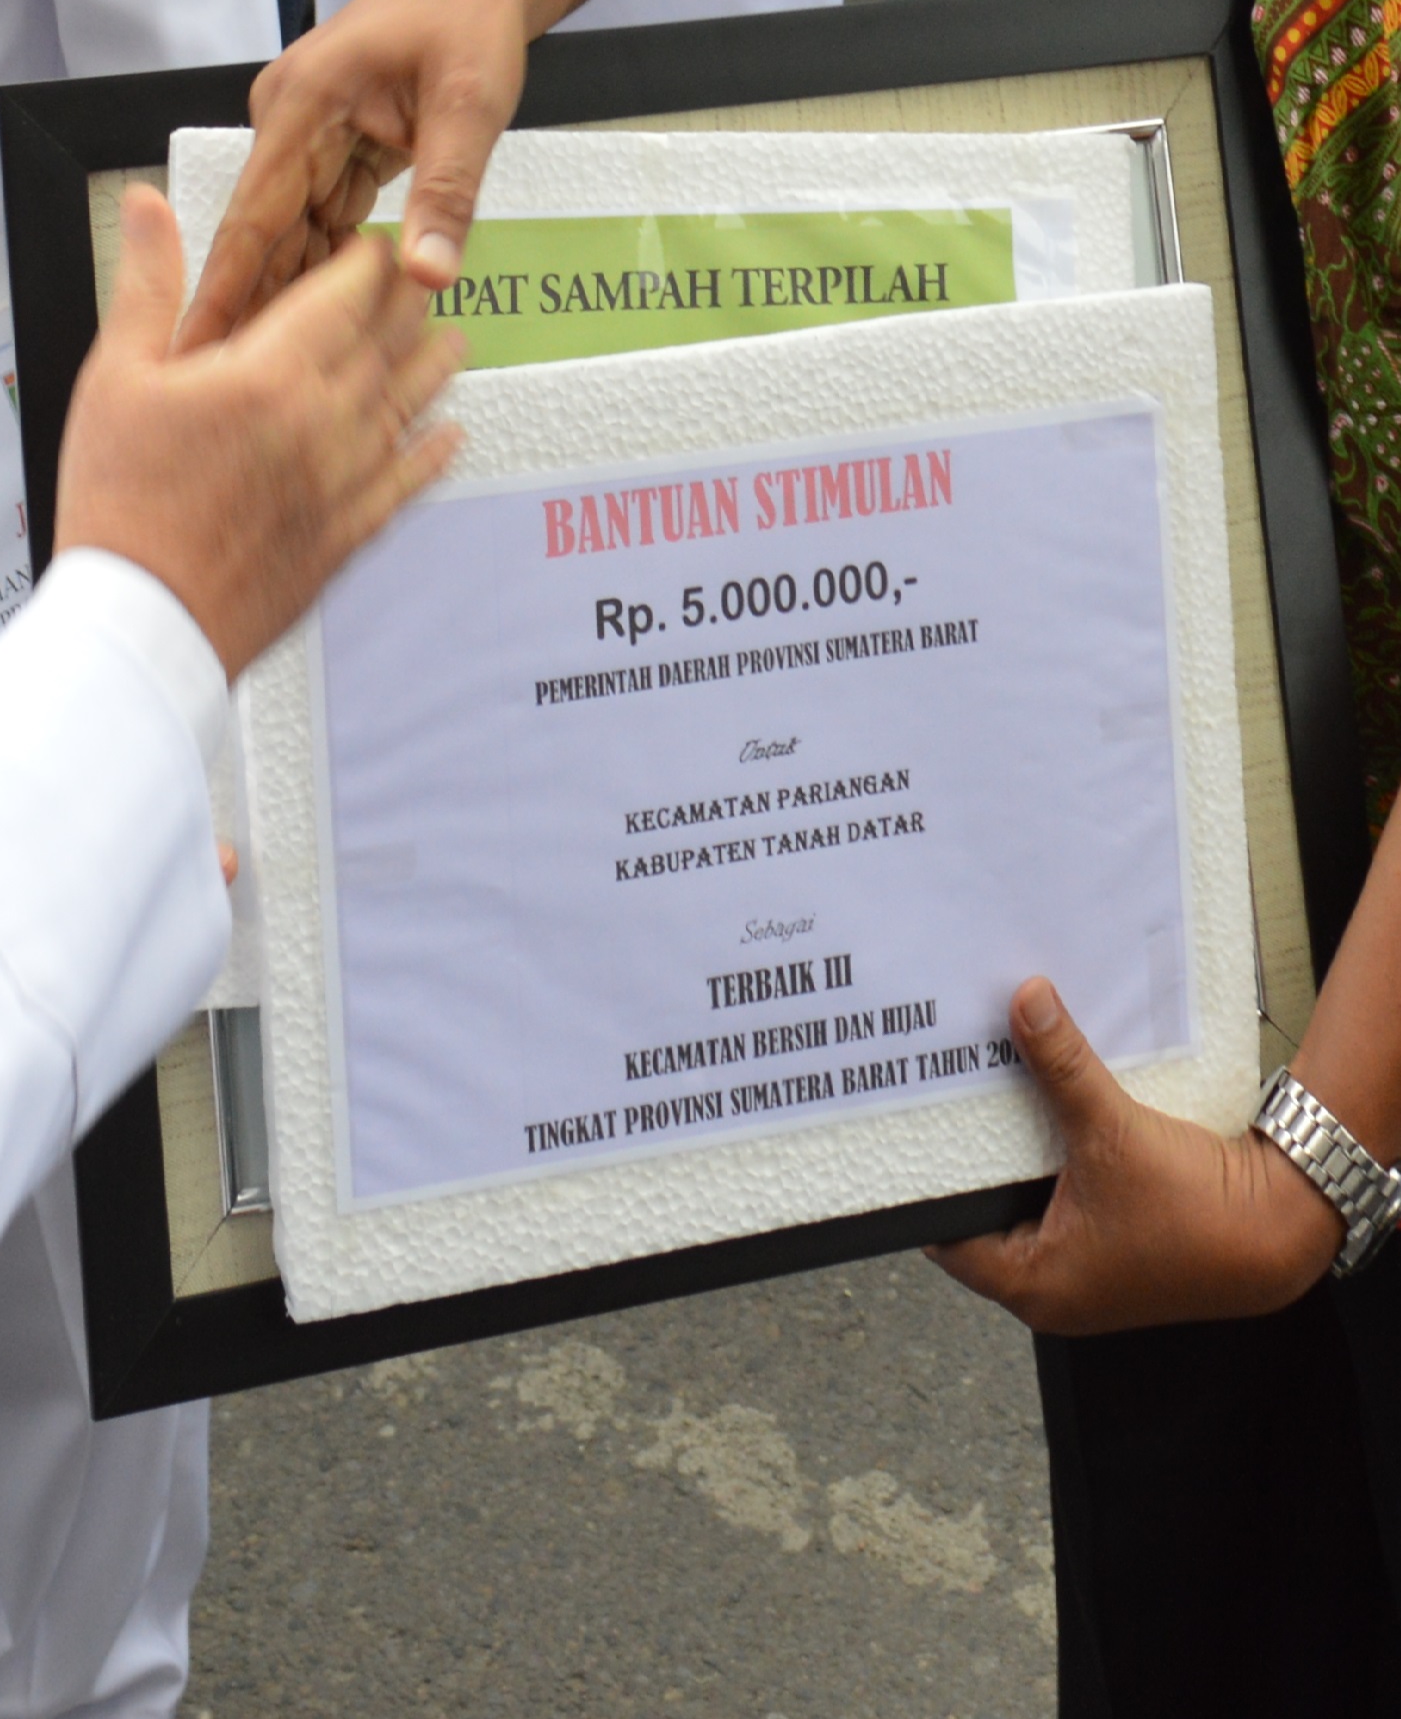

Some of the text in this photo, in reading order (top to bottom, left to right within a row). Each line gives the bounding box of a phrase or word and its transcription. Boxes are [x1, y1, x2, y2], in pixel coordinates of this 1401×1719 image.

[538, 268, 721, 316] SAMPAH
[731, 262, 950, 308] TERPILAH
[542, 449, 954, 559] BANTUAN STIMULAN
[595, 560, 919, 646] Rp. 5.000.000,-
[534, 618, 980, 707] PEMERINTAH DAERAH PROVINSI SUMATERA BARAT
[624, 769, 911, 835] KECAMATAN PARIANGAN
[615, 811, 926, 882] KABUPATEN TANAH DATAR
[739, 912, 817, 945] Sebagai
[706, 953, 853, 1010] TERBAIK III
[624, 999, 938, 1081] KECAMATAN BERSIH DAN HIJAU
[524, 1110, 618, 1154] TINGKAT
[624, 1091, 724, 1135] PROVINSI
[730, 1071, 835, 1116] SUMATERA
[841, 1057, 909, 1096] BARAT
[915, 1044, 981, 1082] TAHUN
